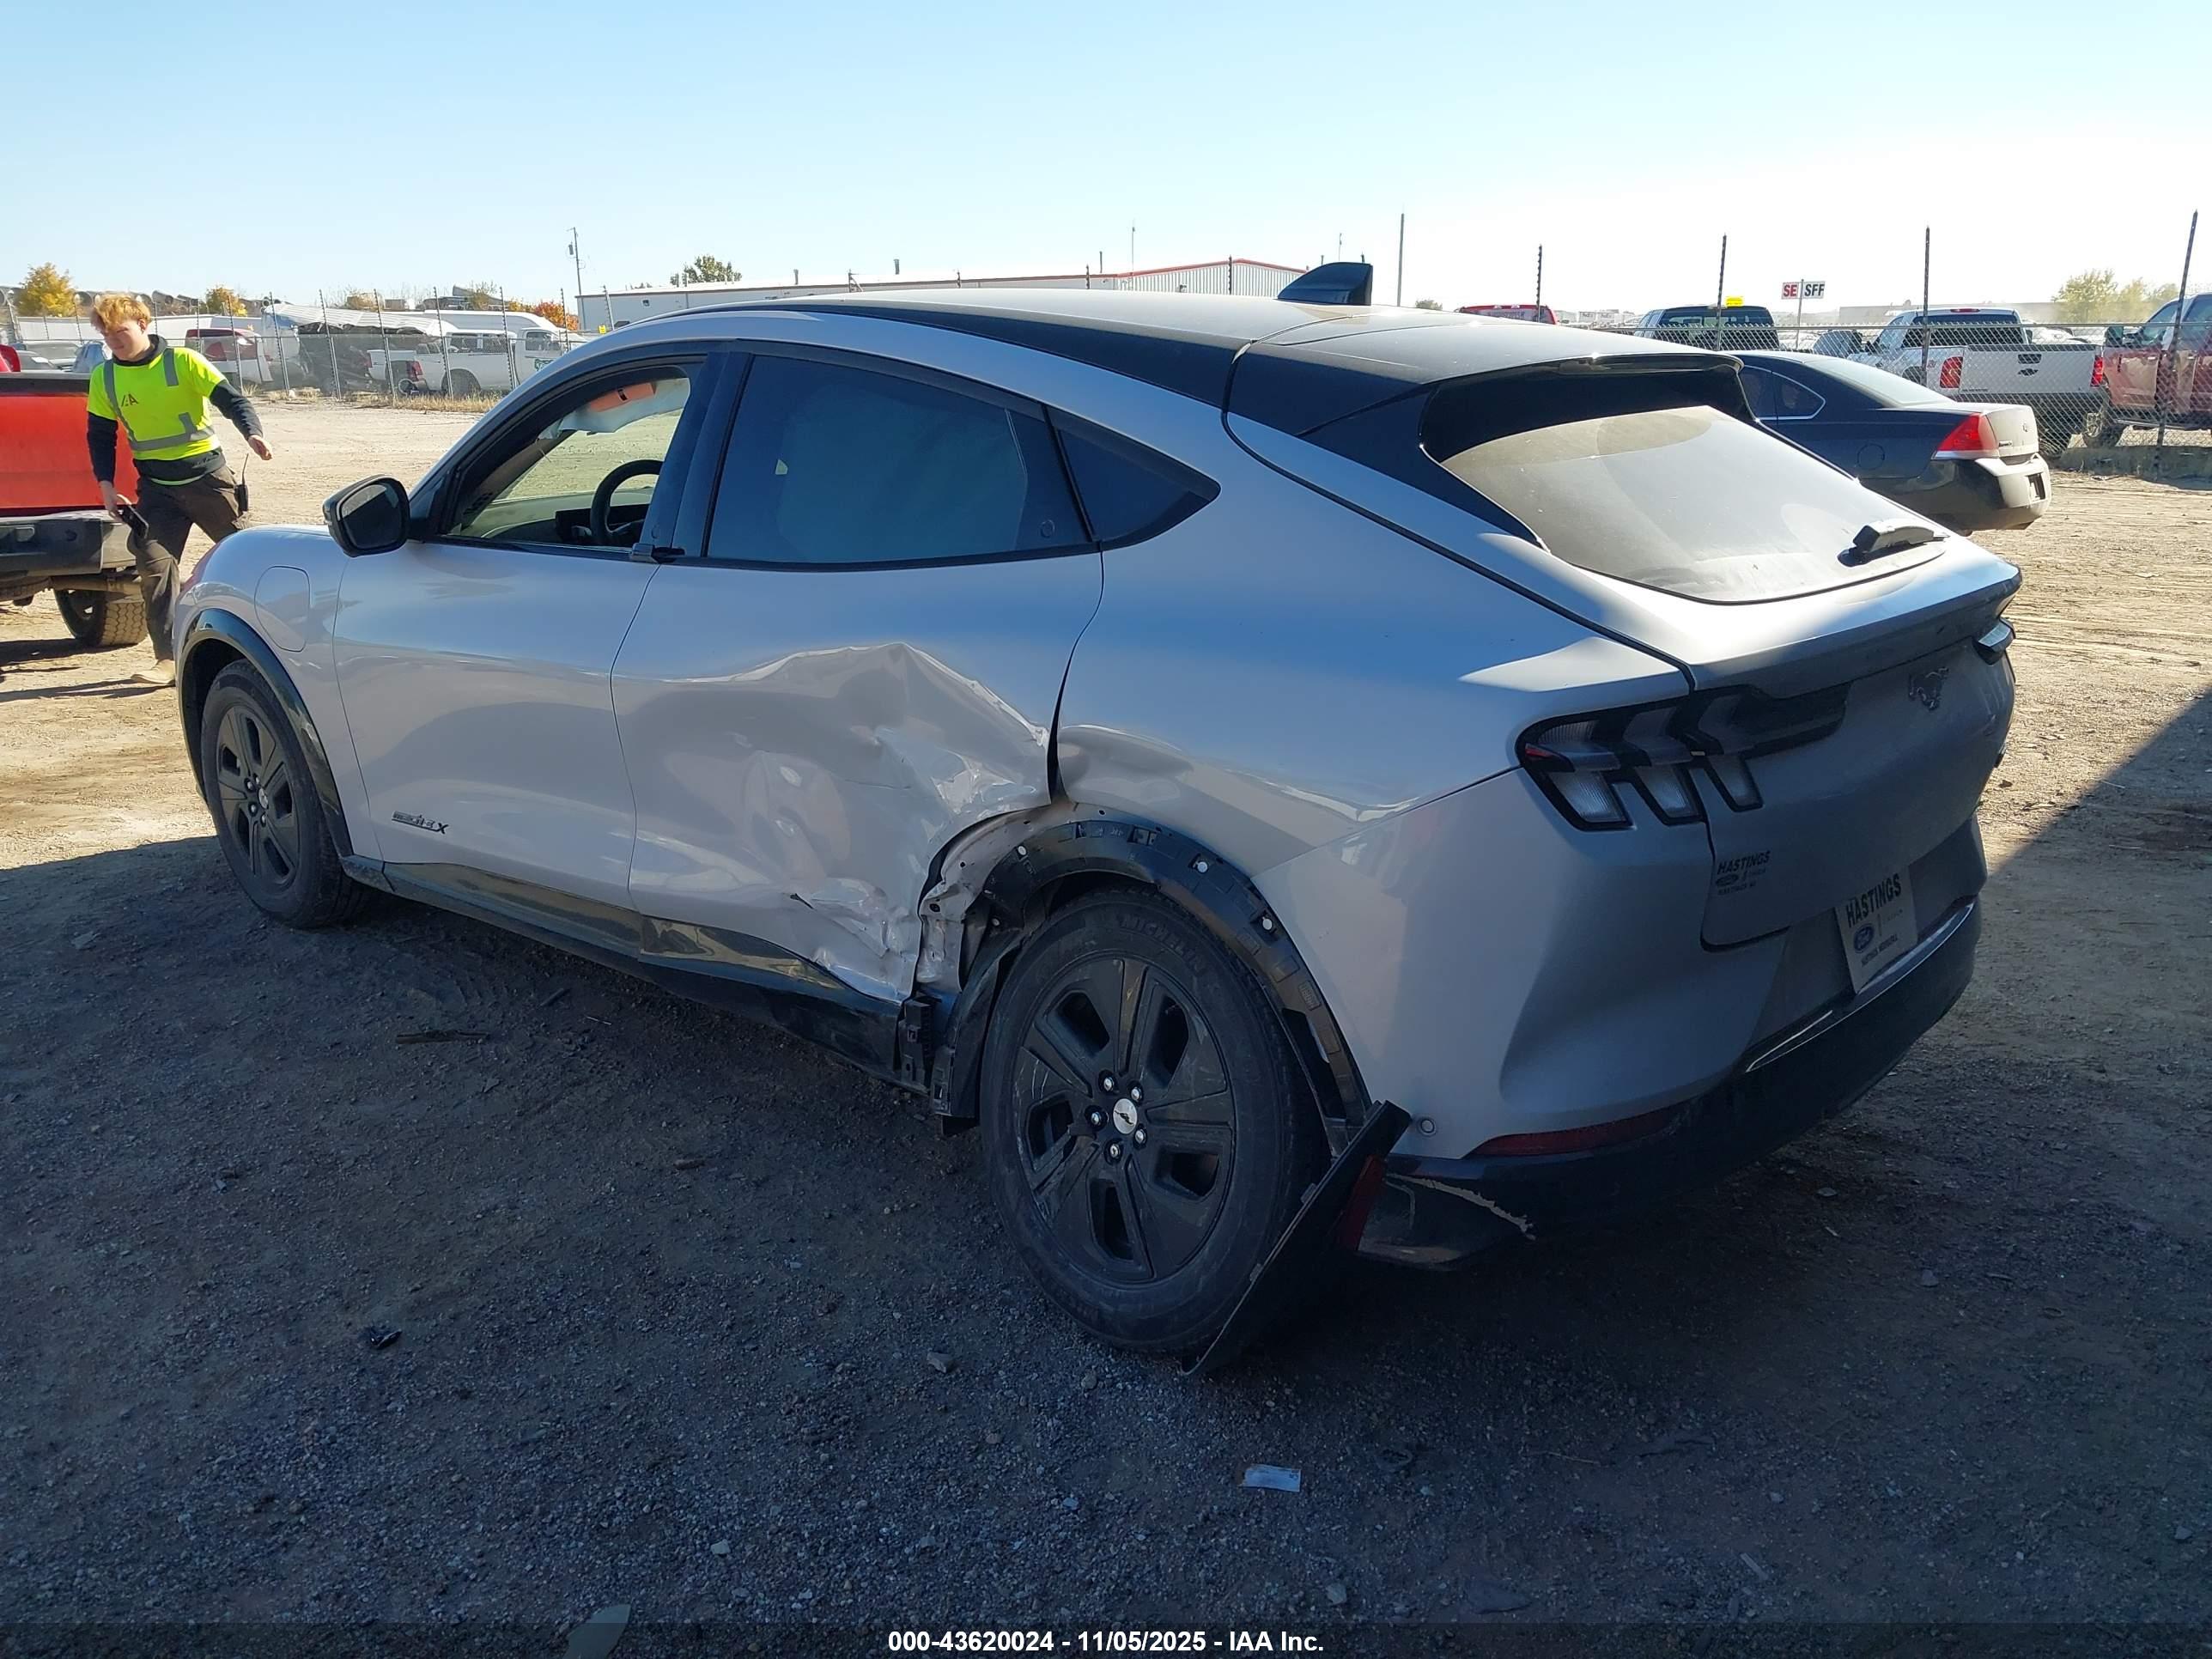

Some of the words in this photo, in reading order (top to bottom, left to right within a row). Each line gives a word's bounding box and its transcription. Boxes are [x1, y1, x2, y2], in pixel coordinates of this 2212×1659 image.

[1783, 284, 1798, 297] SE
[1804, 283, 1825, 297] SFF
[1717, 849, 1771, 875] HASTINGS
[1845, 872, 1902, 928] HASTINGS
